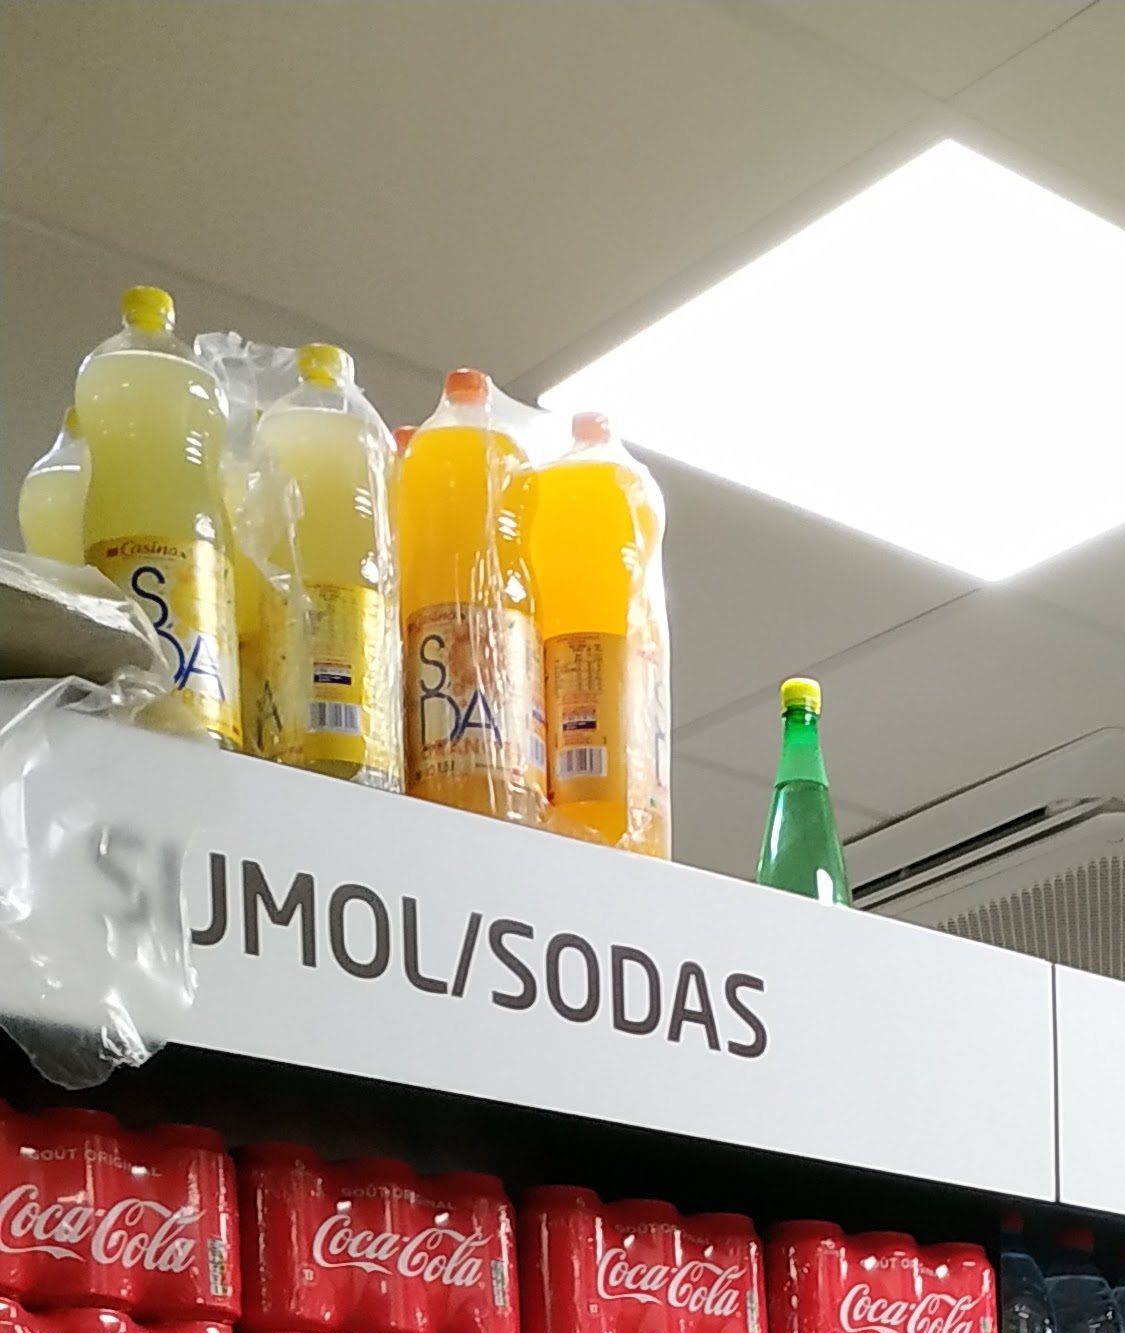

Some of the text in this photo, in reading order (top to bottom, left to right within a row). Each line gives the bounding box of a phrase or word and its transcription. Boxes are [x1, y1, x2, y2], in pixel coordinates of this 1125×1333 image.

[0, 1184, 206, 1273] Coca-Cola
[312, 1213, 494, 1288] Coca-Cola
[596, 1247, 747, 1318] Coca-Cola
